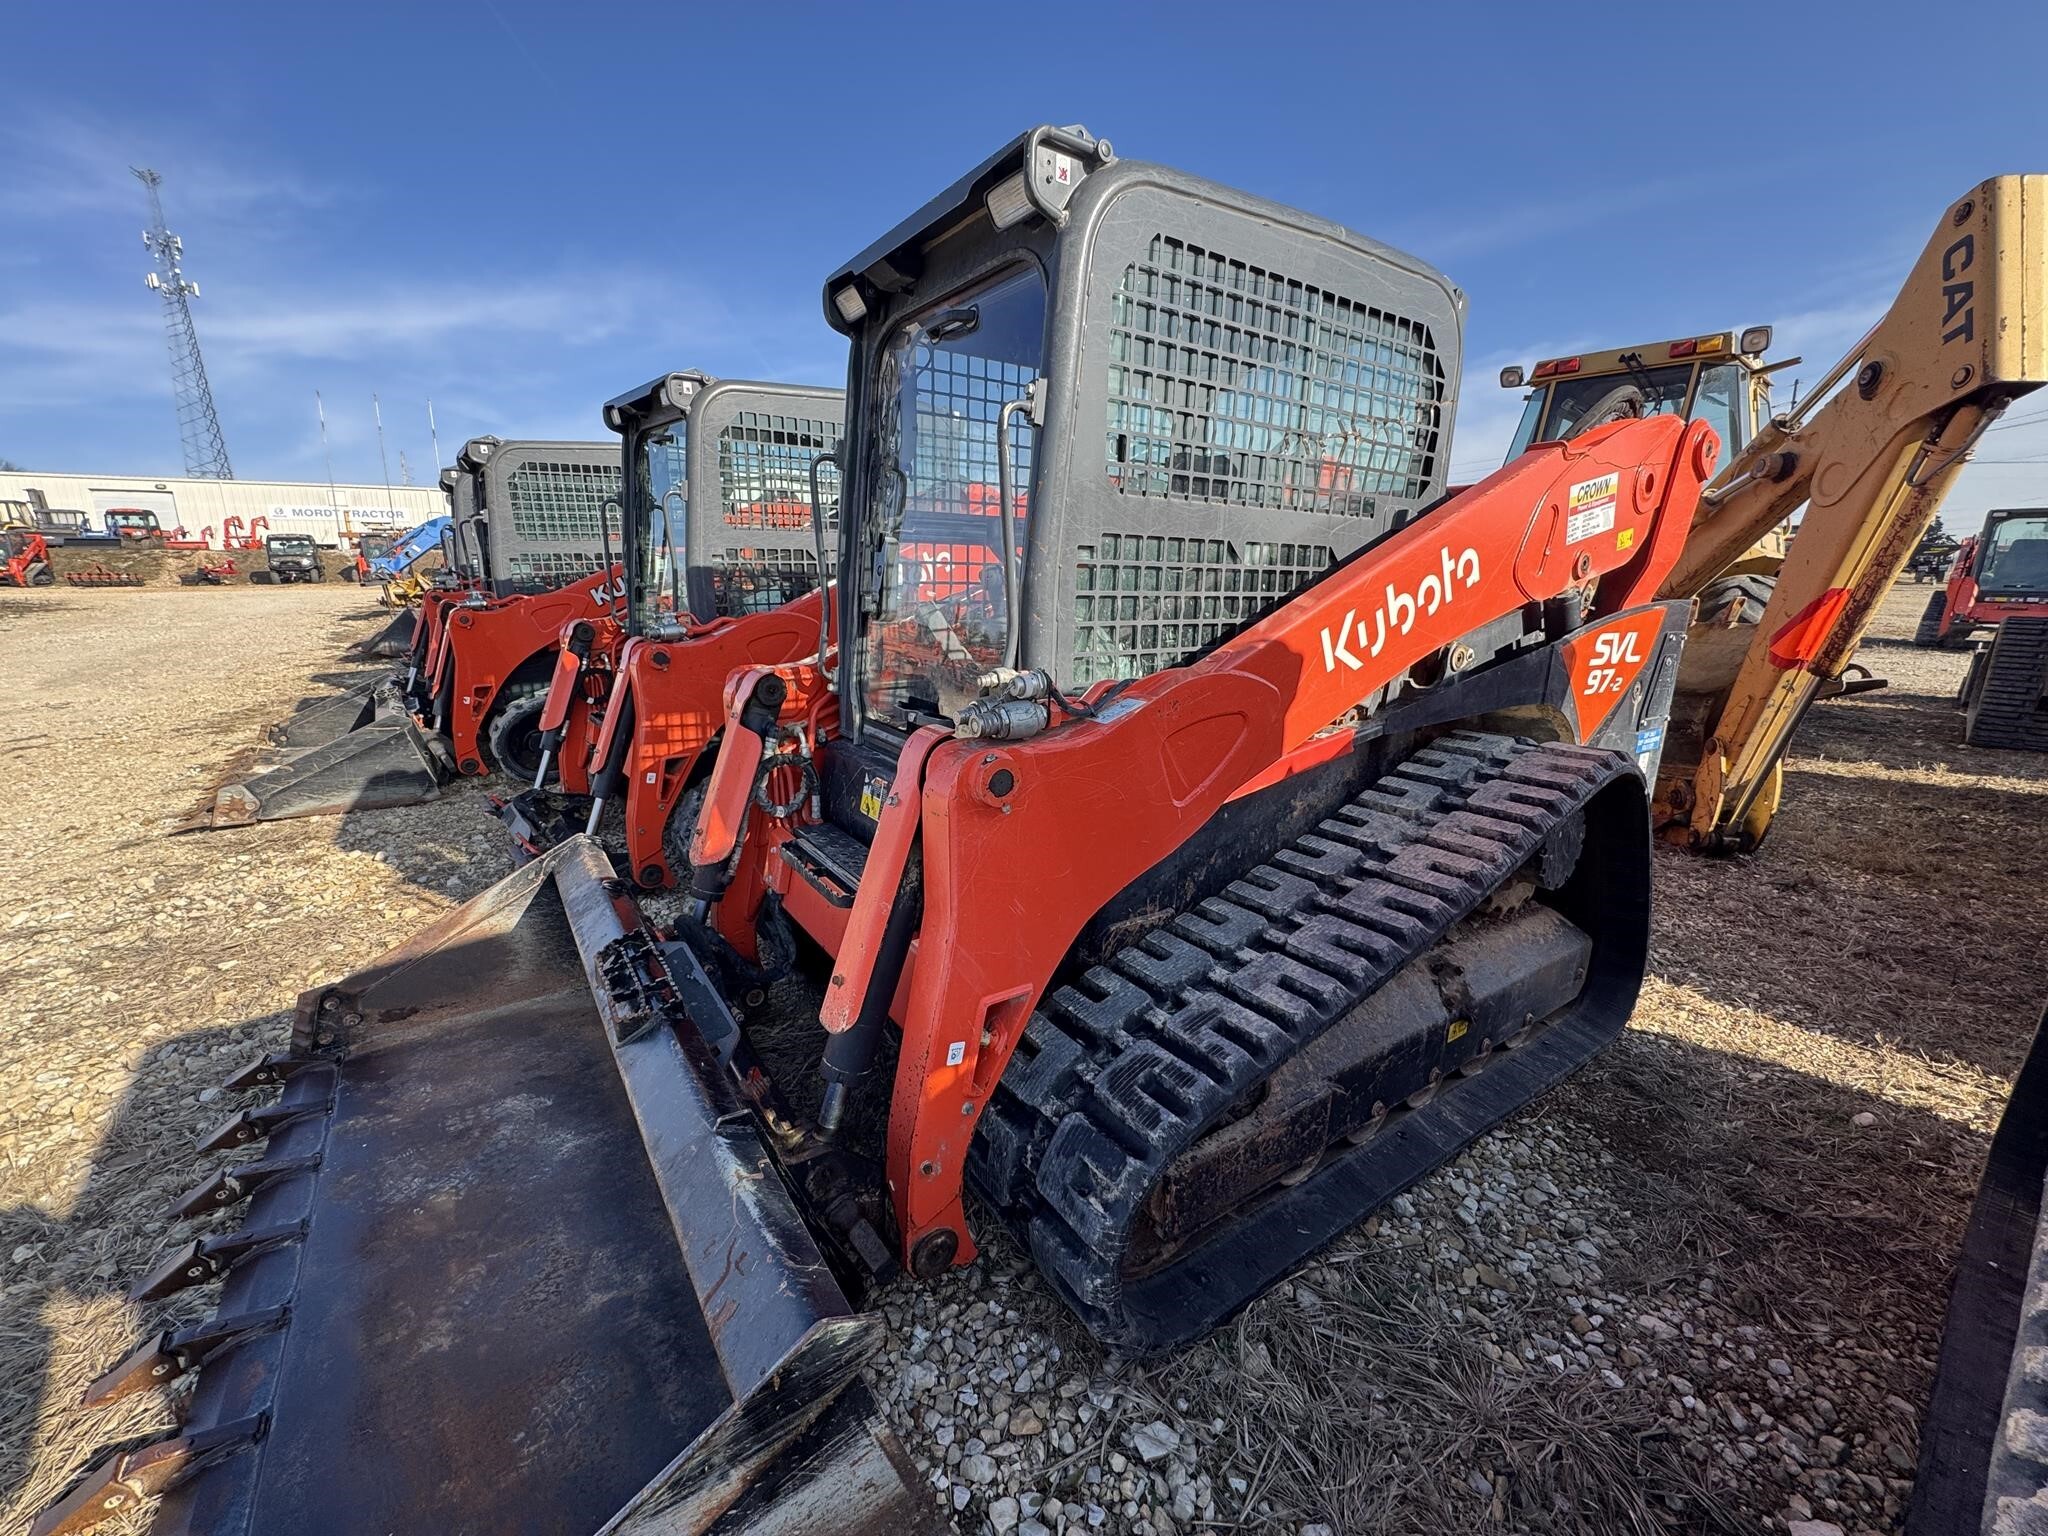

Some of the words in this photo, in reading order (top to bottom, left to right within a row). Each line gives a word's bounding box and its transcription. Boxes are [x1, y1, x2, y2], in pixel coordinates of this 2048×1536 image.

[1942, 234, 1974, 346] CAT
[1577, 477, 1611, 503] CROWN
[1320, 546, 1481, 673] Kubota
[1588, 631, 1641, 667] SVL
